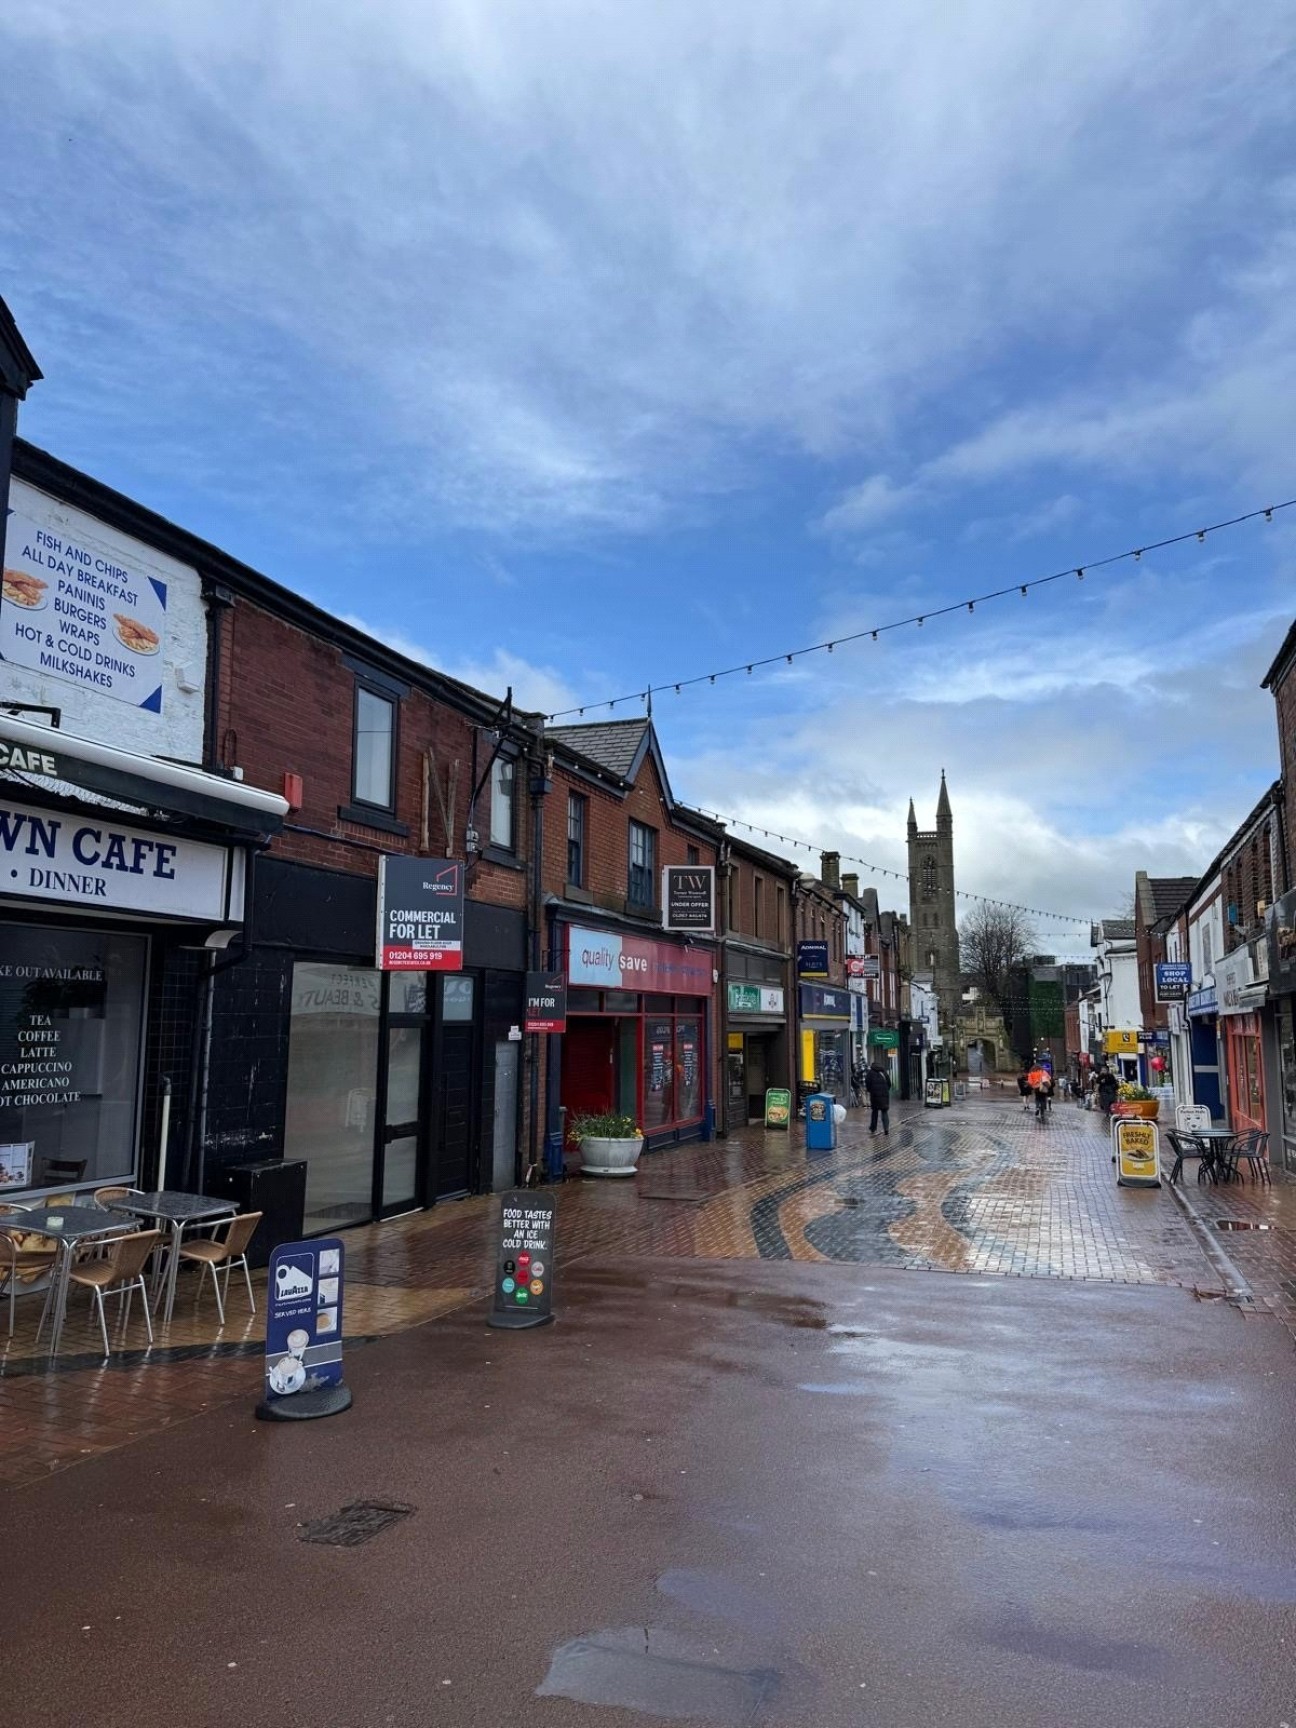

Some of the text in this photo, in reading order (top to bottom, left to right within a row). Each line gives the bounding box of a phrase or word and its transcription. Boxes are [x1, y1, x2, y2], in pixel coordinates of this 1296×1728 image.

[36, 530, 128, 583] FISH AND CHIPS
[22, 545, 138, 606] ALL DAY BREAKFAST
[58, 580, 105, 610] PANINIS
[54, 598, 107, 630] BURGERS
[59, 620, 99, 646] WRAPS
[16, 623, 135, 677] HOT & COLD DRINKS
[40, 652, 112, 688] MILKSHAKES
[0, 742, 58, 776] CAFE
[72, 827, 177, 880] CAFE
[30, 868, 107, 897] DINNER
[422, 881, 455, 892] Regency
[673, 875, 707, 889] TW
[390, 909, 456, 924] COMMERCIAL
[389, 923, 441, 939] FOR LET
[389, 951, 442, 960] 01204 695 919
[582, 948, 614, 970] quality
[619, 955, 647, 972] save
[16, 965, 41, 978] OUT
[42, 967, 102, 981] AVAILABLE
[528, 997, 555, 1007] I'M FOR
[29, 1014, 52, 1026] TEA
[18, 1030, 61, 1042] COFFEE
[20, 1047, 56, 1058] LATTE
[1, 1061, 72, 1075] CAPPUCCINO
[2, 1077, 70, 1091] AMERICANO
[14, 1091, 81, 1106] CHOCOLATE
[1123, 1131, 1151, 1139] FRESHLY
[503, 1208, 552, 1219] FOOD TASTES
[503, 1219, 550, 1230] BETTER WITH
[514, 1230, 538, 1239] AN ICE
[502, 1239, 547, 1250] COLD DRINK.
[281, 1285, 308, 1297] LAVAZZA
[274, 1310, 296, 1318] SERVED
